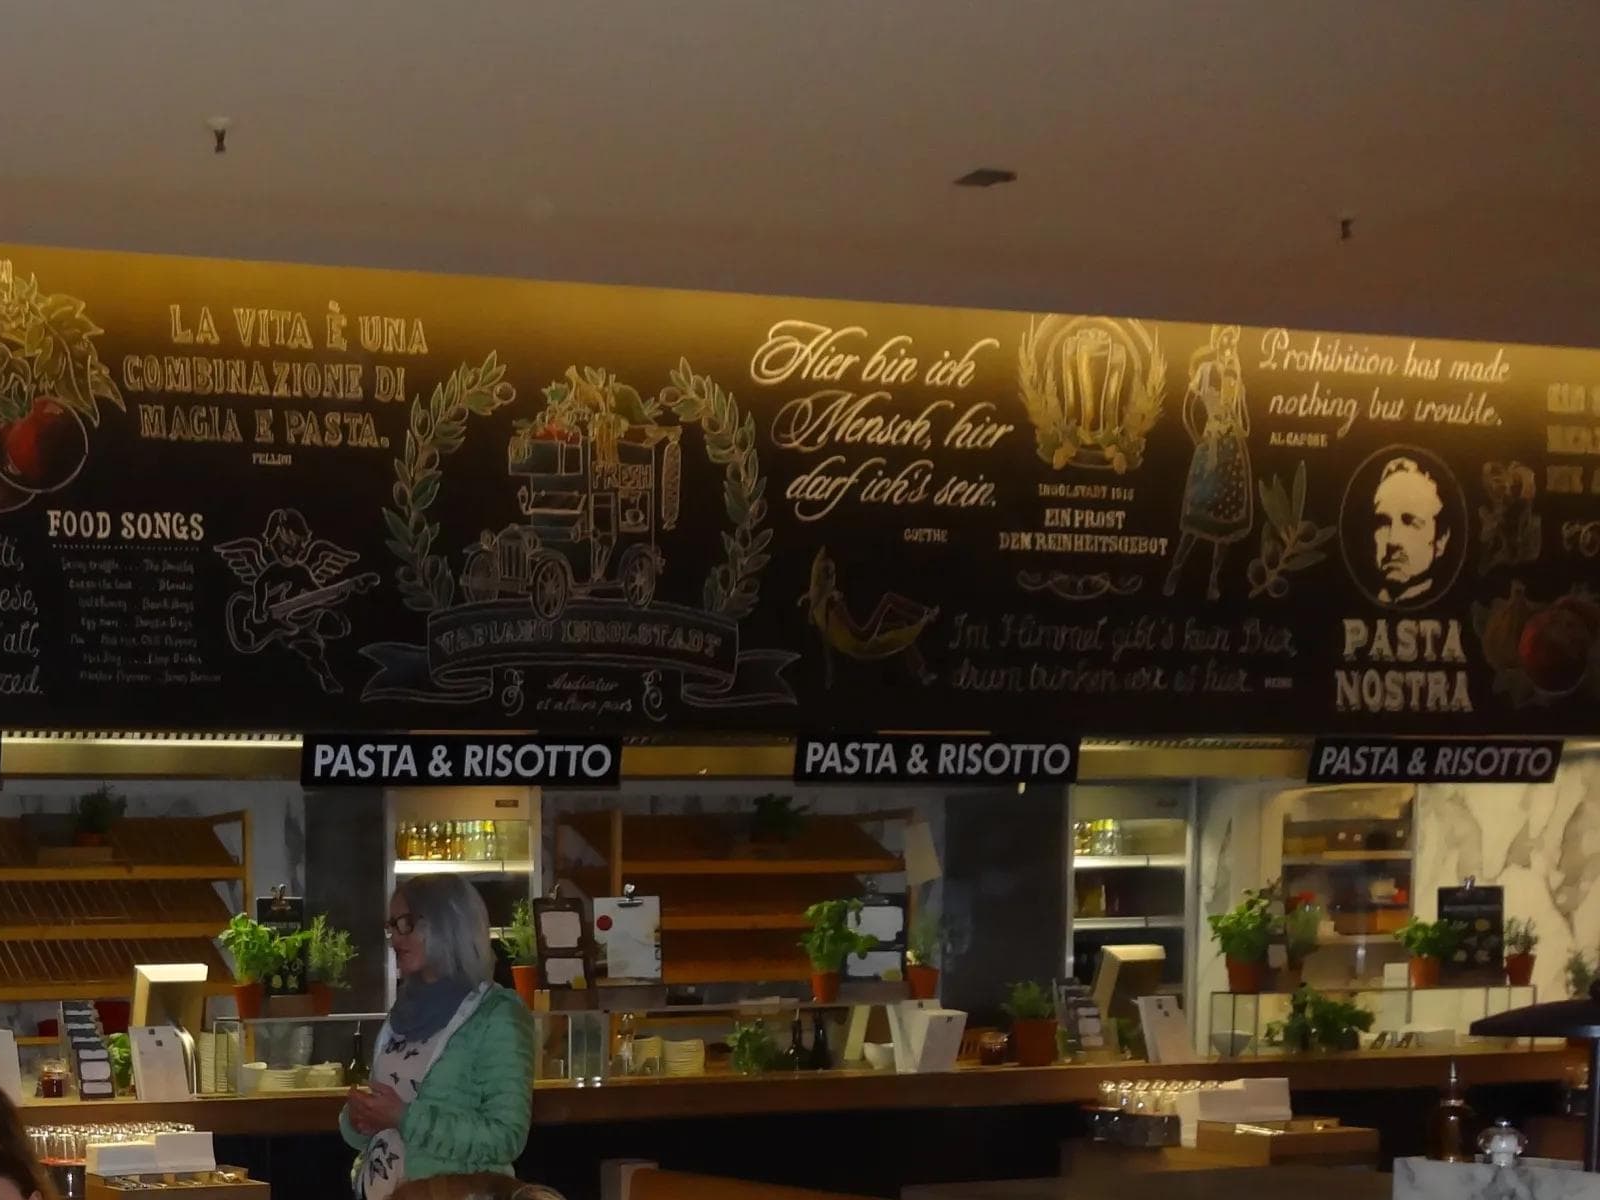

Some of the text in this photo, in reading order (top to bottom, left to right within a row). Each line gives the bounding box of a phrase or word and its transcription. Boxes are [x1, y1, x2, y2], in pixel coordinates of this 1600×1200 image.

[169, 300, 429, 354] LA VITA È UNA
[750, 319, 1000, 389] Hier bin ich
[1259, 327, 1510, 383] Prohibition has made
[123, 355, 406, 402] COMBINAZIONE DI
[138, 404, 390, 449] MAGIA E PASTA.
[770, 389, 1015, 453] Mensch, hier
[1269, 381, 1502, 439] nothing but trouble.
[785, 455, 886, 522] darf
[934, 474, 997, 509] sein.
[46, 510, 204, 541] FOOD SONGS
[1044, 508, 1126, 530] EIN PROST
[998, 531, 1168, 556] DEM REINHEITSGEBOT
[1342, 618, 1467, 662] PASTA
[1335, 669, 1474, 712] NOSTRA
[313, 743, 612, 777] PASTA & RISOTTO
[805, 742, 1071, 775] PASTA & RISOTTO
[1318, 746, 1552, 777] PASTA & RISOTTO
